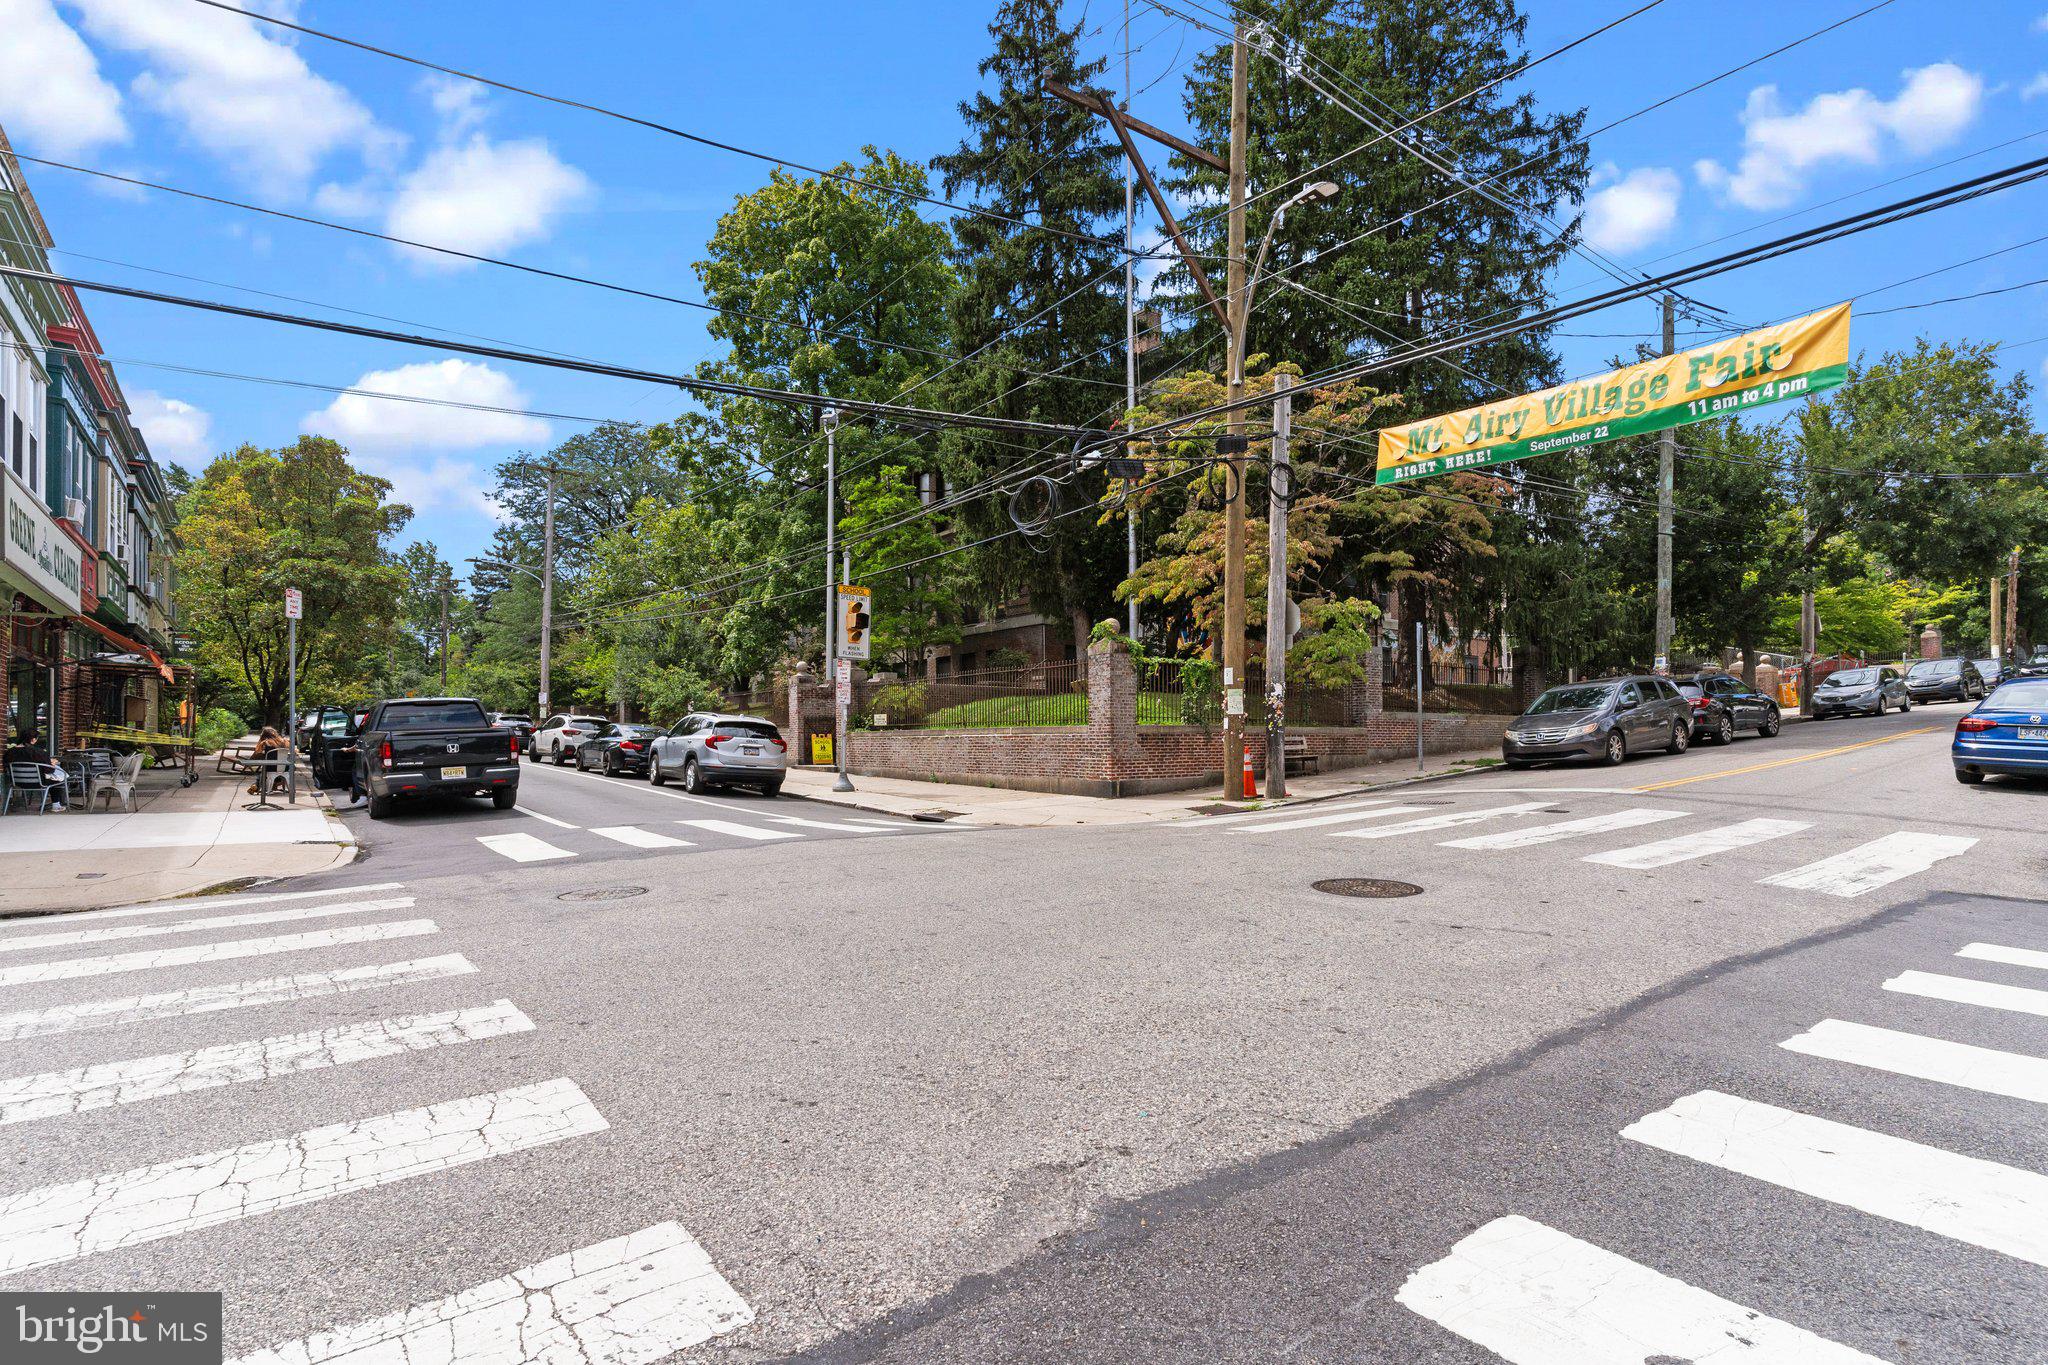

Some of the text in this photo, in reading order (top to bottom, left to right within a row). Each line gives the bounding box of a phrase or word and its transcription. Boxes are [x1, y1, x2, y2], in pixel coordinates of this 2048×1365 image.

[1407, 340, 1782, 456] Mt. Airy Village Fair
[1688, 376, 1808, 416] 11 am to 4 pm
[1530, 426, 1609, 452] September 22
[1395, 449, 1492, 479] RIGHT HERE!
[842, 587, 867, 595] SCHOOL
